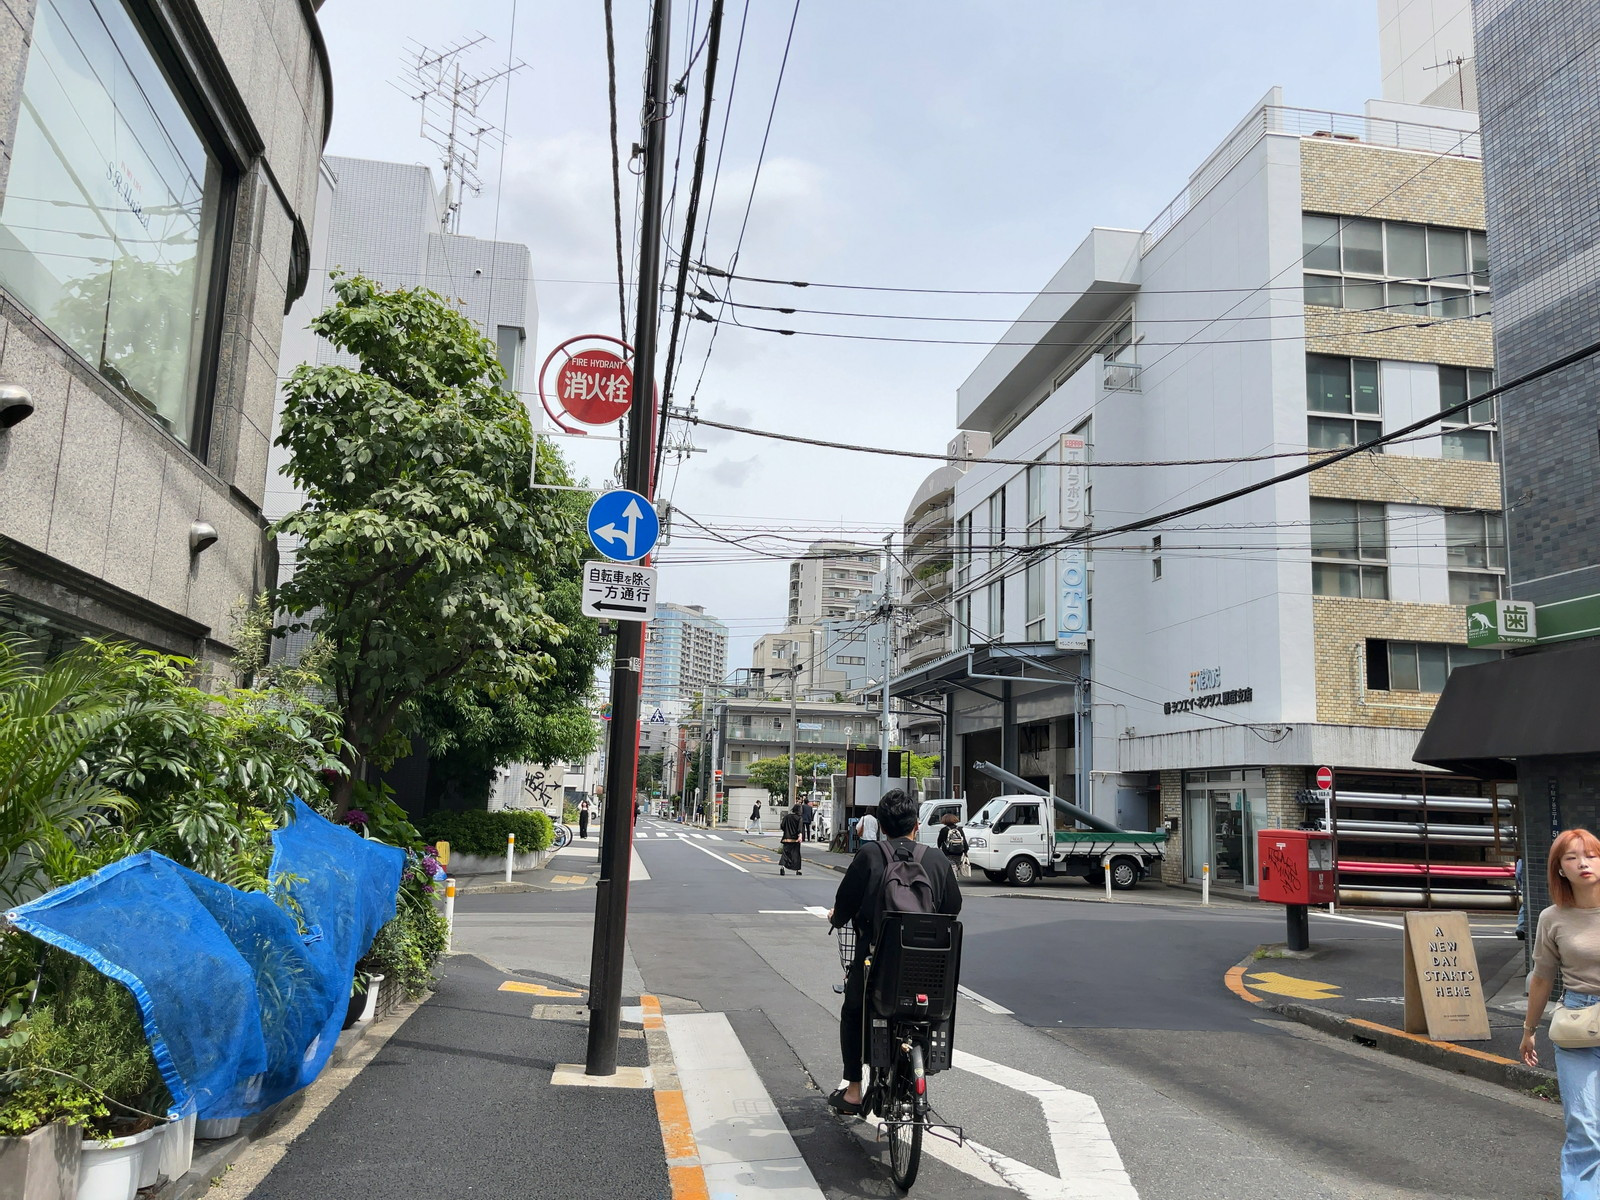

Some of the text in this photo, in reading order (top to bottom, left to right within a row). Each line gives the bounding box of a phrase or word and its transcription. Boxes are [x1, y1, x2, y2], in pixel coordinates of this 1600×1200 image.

[571, 357, 624, 369] FIRE HYDRANT
[563, 370, 631, 403] 消火栓
[589, 568, 651, 587] 自転車を除く
[588, 585, 650, 602] 一方通行
[1502, 605, 1529, 633] 歯
[1435, 926, 1444, 937] A
[1428, 941, 1457, 953] NEW
[1432, 956, 1457, 967] DAY
[1423, 970, 1475, 982] STARTS
[1435, 986, 1471, 997] HERE
